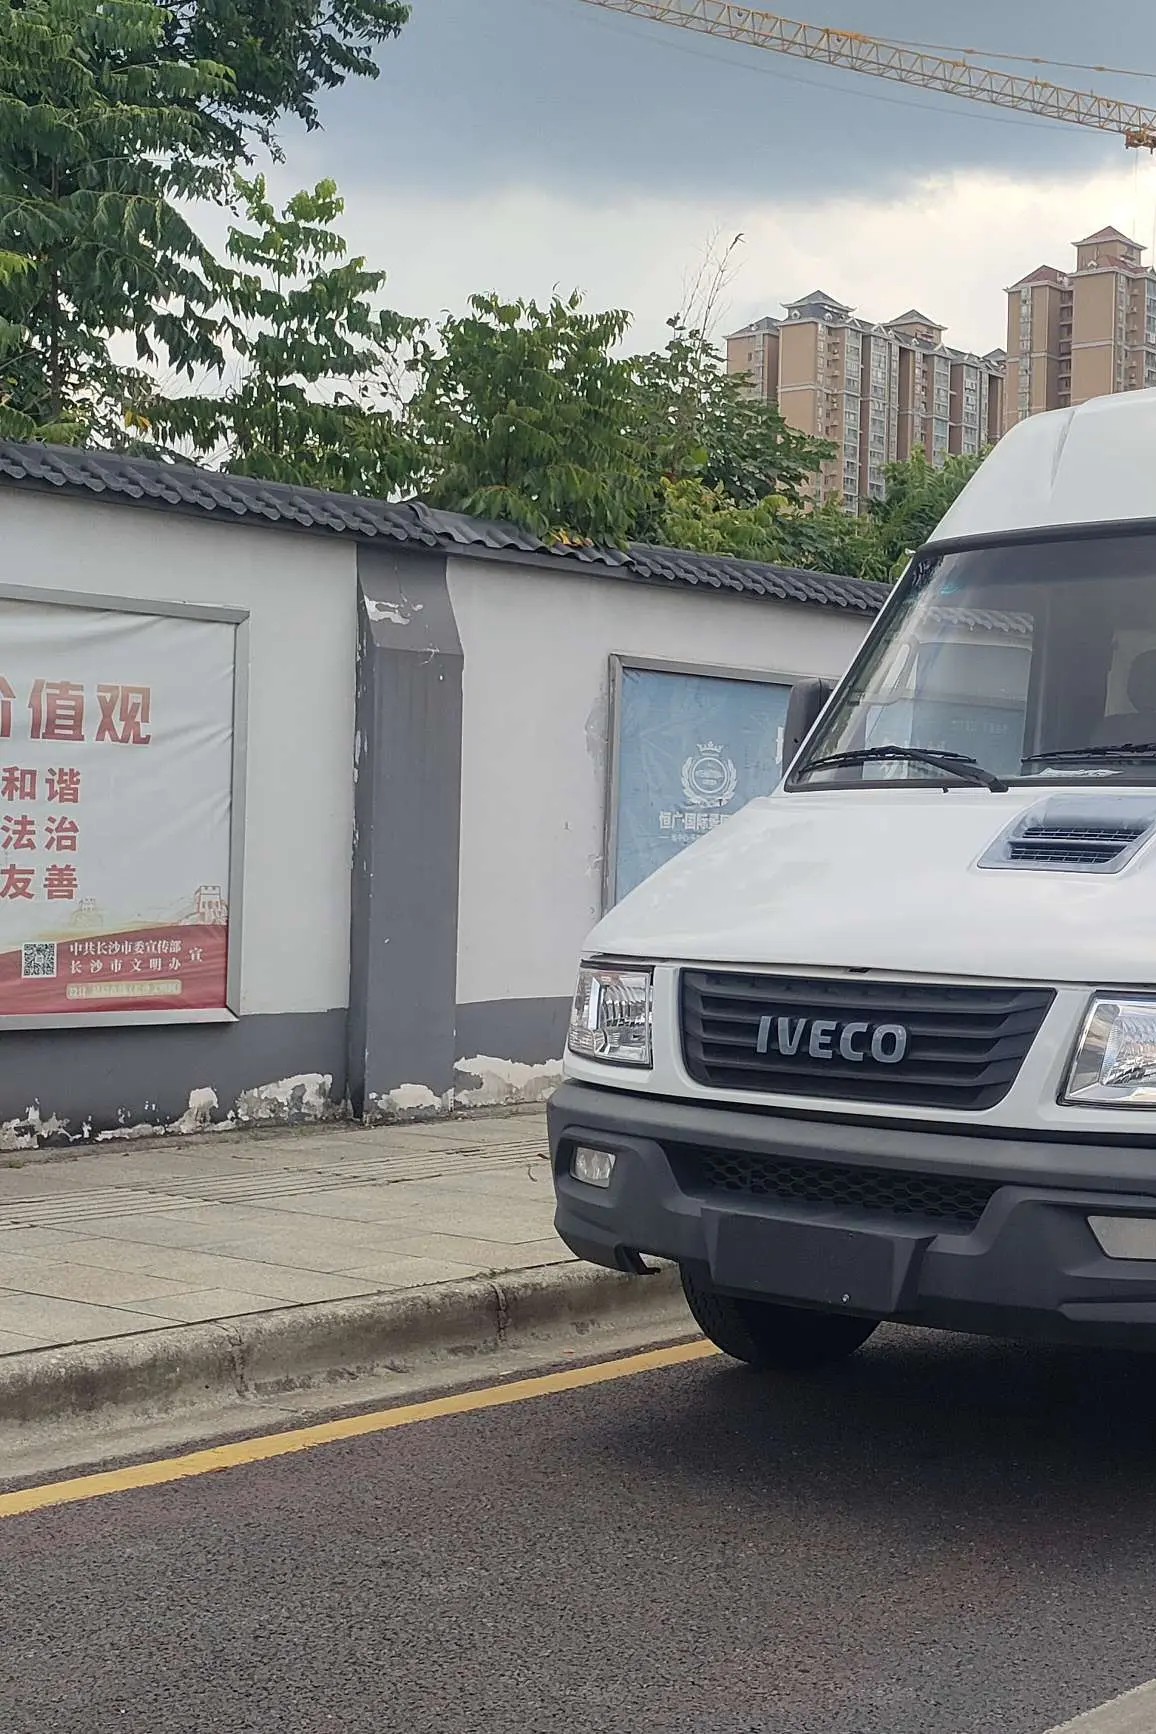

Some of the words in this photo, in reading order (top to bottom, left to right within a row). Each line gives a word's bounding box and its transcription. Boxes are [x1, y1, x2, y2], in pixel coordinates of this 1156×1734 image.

[1, 766, 80, 803] 和谐
[1, 815, 79, 851] 法治
[0, 864, 78, 899] 友善
[70, 940, 182, 956] 中共长沙市委宣传部
[189, 947, 204, 962] 宣
[71, 958, 181, 974] 长沙市文明办
[756, 1015, 907, 1063] IVECO
